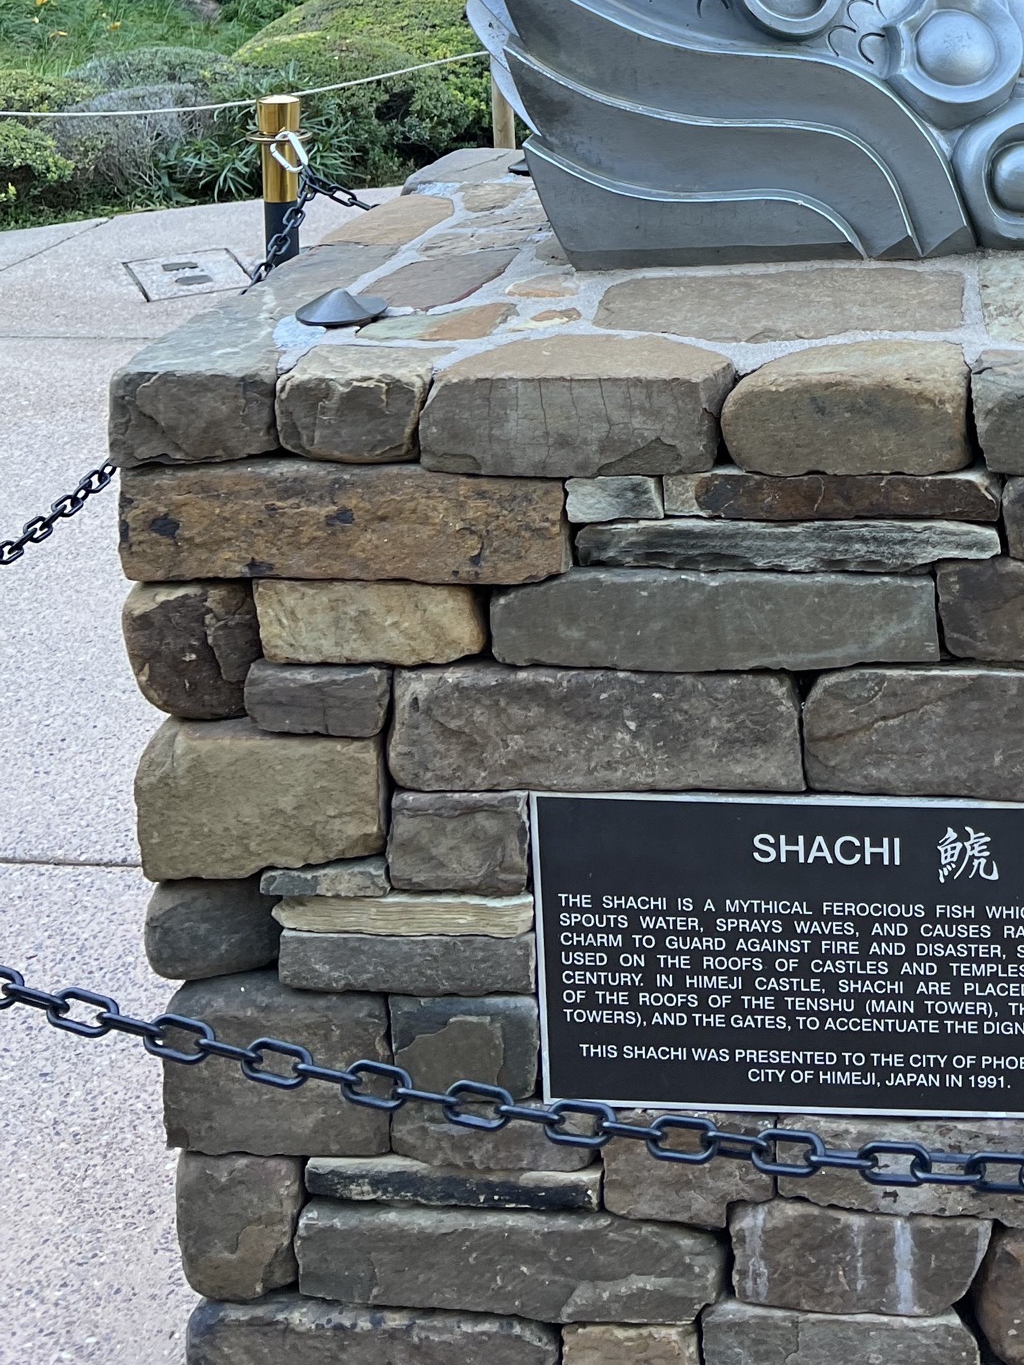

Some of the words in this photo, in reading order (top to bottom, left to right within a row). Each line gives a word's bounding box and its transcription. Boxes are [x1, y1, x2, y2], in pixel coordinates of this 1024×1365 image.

[753, 834, 900, 865] SHACHI
[558, 893, 592, 907] THE
[602, 895, 666, 910] SHACHI
[678, 898, 693, 911] IS
[704, 899, 715, 912] A
[726, 899, 813, 914] MYTHICAL
[823, 902, 925, 917] FEROCIOUS
[936, 905, 974, 918] FISH
[560, 913, 628, 928] SPOUTS
[640, 916, 703, 933] WATER,
[716, 918, 782, 933] SPRAYS
[794, 921, 859, 937] WAVES,
[871, 923, 908, 936] AND
[920, 924, 991, 938] CAUSES
[560, 932, 622, 947] CHARM
[632, 935, 655, 948] TO
[666, 936, 726, 950] GUARD
[736, 938, 811, 953] AGAINST
[822, 941, 859, 954] FIRE
[869, 942, 906, 955] AND
[916, 943, 1006, 960] DISASTER,
[562, 951, 607, 966] USED
[620, 953, 645, 967] ON
[656, 955, 691, 969] THE
[703, 956, 763, 971] ROOFS
[775, 958, 799, 972] OF
[811, 959, 888, 974] CASTLES
[900, 962, 937, 975] AND
[562, 970, 643, 986] CENTURY.
[657, 974, 673, 987] IN
[686, 975, 742, 989] HIMEJI
[755, 977, 825, 994] CASTLE,
[838, 979, 903, 994] SHACHI
[916, 981, 951, 995] ARE
[563, 990, 586, 1003] OF
[595, 991, 629, 1005] THE
[639, 993, 698, 1007] ROOFS
[708, 995, 732, 1008] OF
[741, 996, 775, 1009] THE
[784, 997, 854, 1012] TENSHU
[866, 1000, 914, 1015] (MAIN
[924, 1001, 998, 1018] TOWER),
[563, 1009, 646, 1027] TOWERS),
[651, 1012, 687, 1026] AND
[692, 1013, 726, 1027] THE
[731, 1014, 791, 1031] GATES,
[796, 1017, 820, 1030] TO
[824, 1018, 939, 1033] ACCENTUATE
[944, 1020, 978, 1034] THE
[579, 1044, 617, 1058] THIS
[623, 1045, 686, 1060] SHACHI
[691, 1048, 729, 1062] WAS
[735, 1049, 837, 1065] PRESENTED
[842, 1052, 865, 1066] TO
[870, 1053, 904, 1067] THE
[910, 1054, 948, 1068] CITY
[953, 1055, 976, 1068] OF
[748, 1069, 786, 1082] CITY
[791, 1070, 814, 1083] OF
[819, 1071, 880, 1087] HIMEJI,
[885, 1073, 940, 1087] JAPAN
[946, 1074, 962, 1087] IN
[969, 1075, 1011, 1088] 1991.
